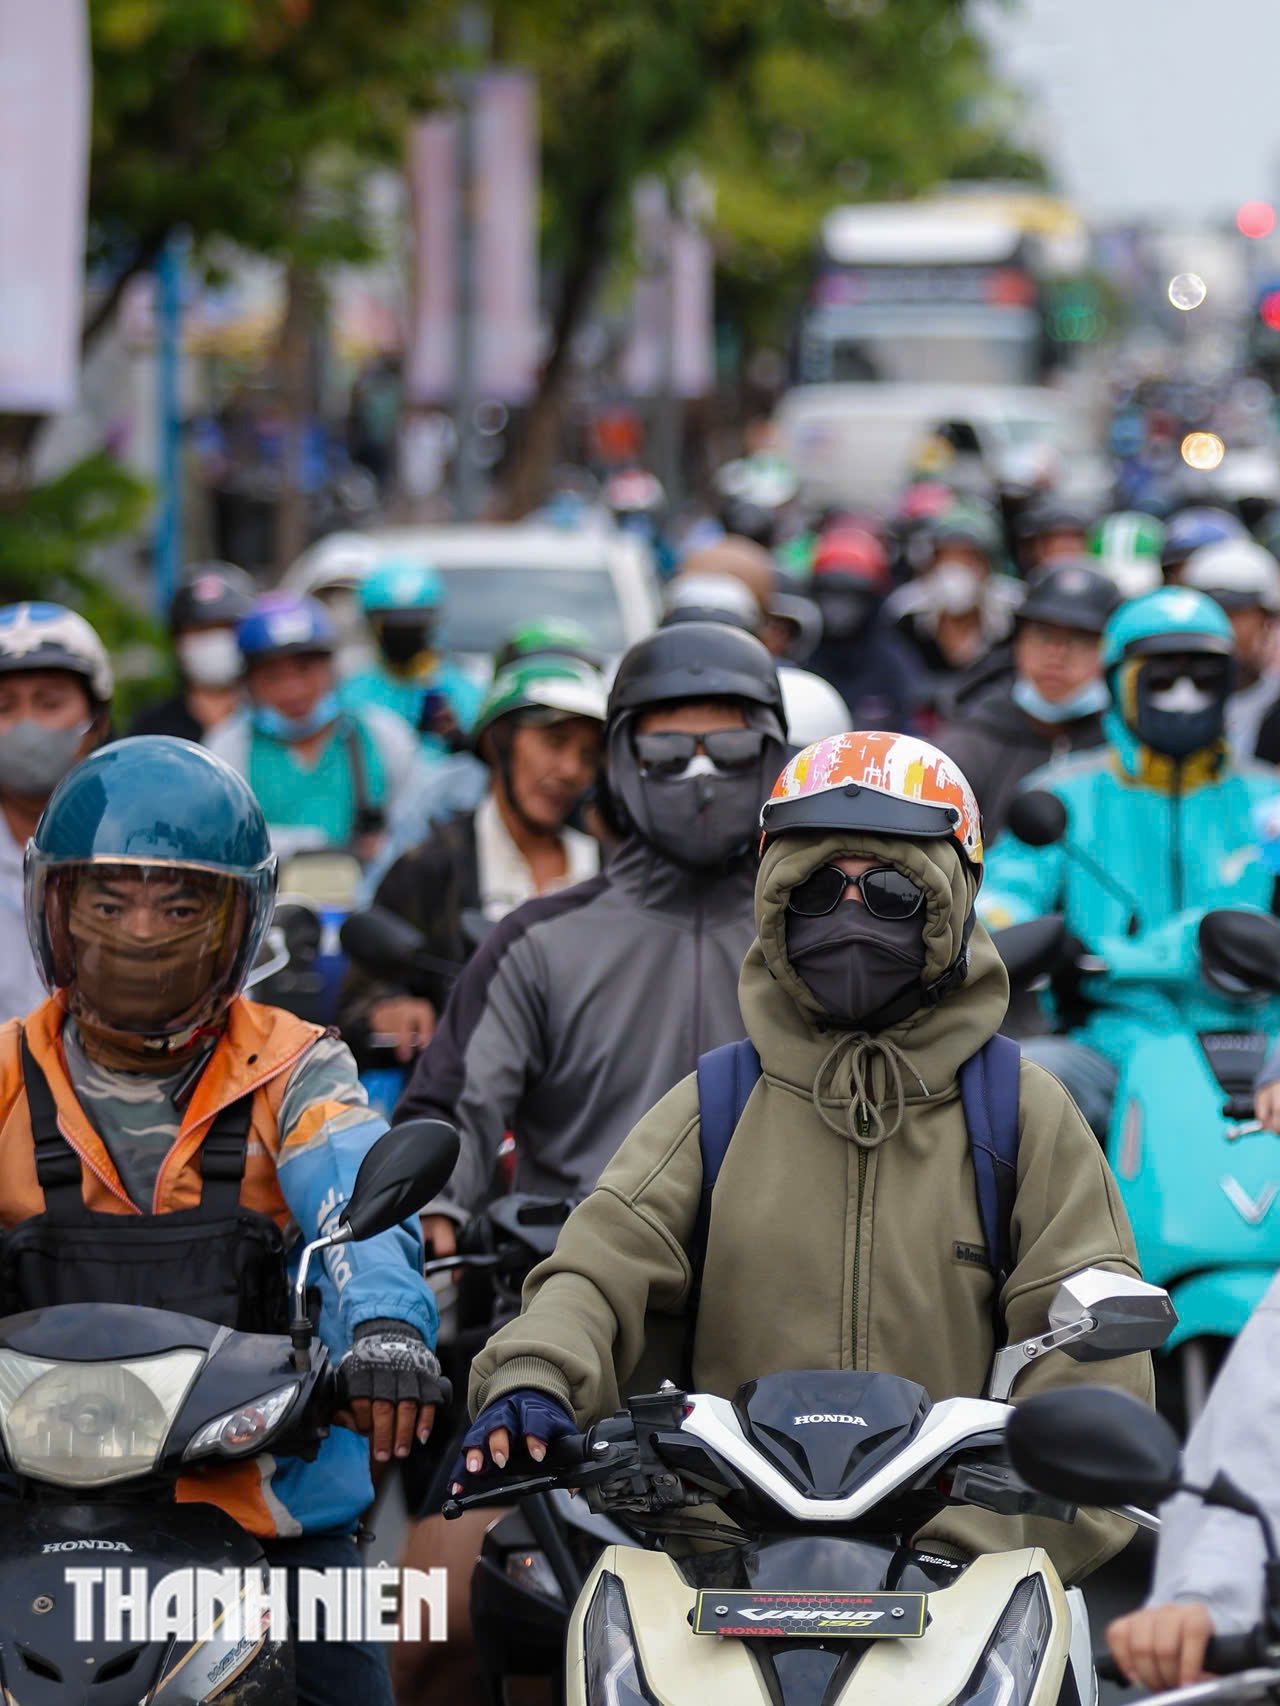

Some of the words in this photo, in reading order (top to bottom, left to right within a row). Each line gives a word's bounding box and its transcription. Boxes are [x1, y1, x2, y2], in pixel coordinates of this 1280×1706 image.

[793, 1414, 869, 1427] HONDA
[42, 1540, 133, 1553] HONDA
[737, 1608, 885, 1621] VARIO
[718, 1627, 786, 1635] HONDA
